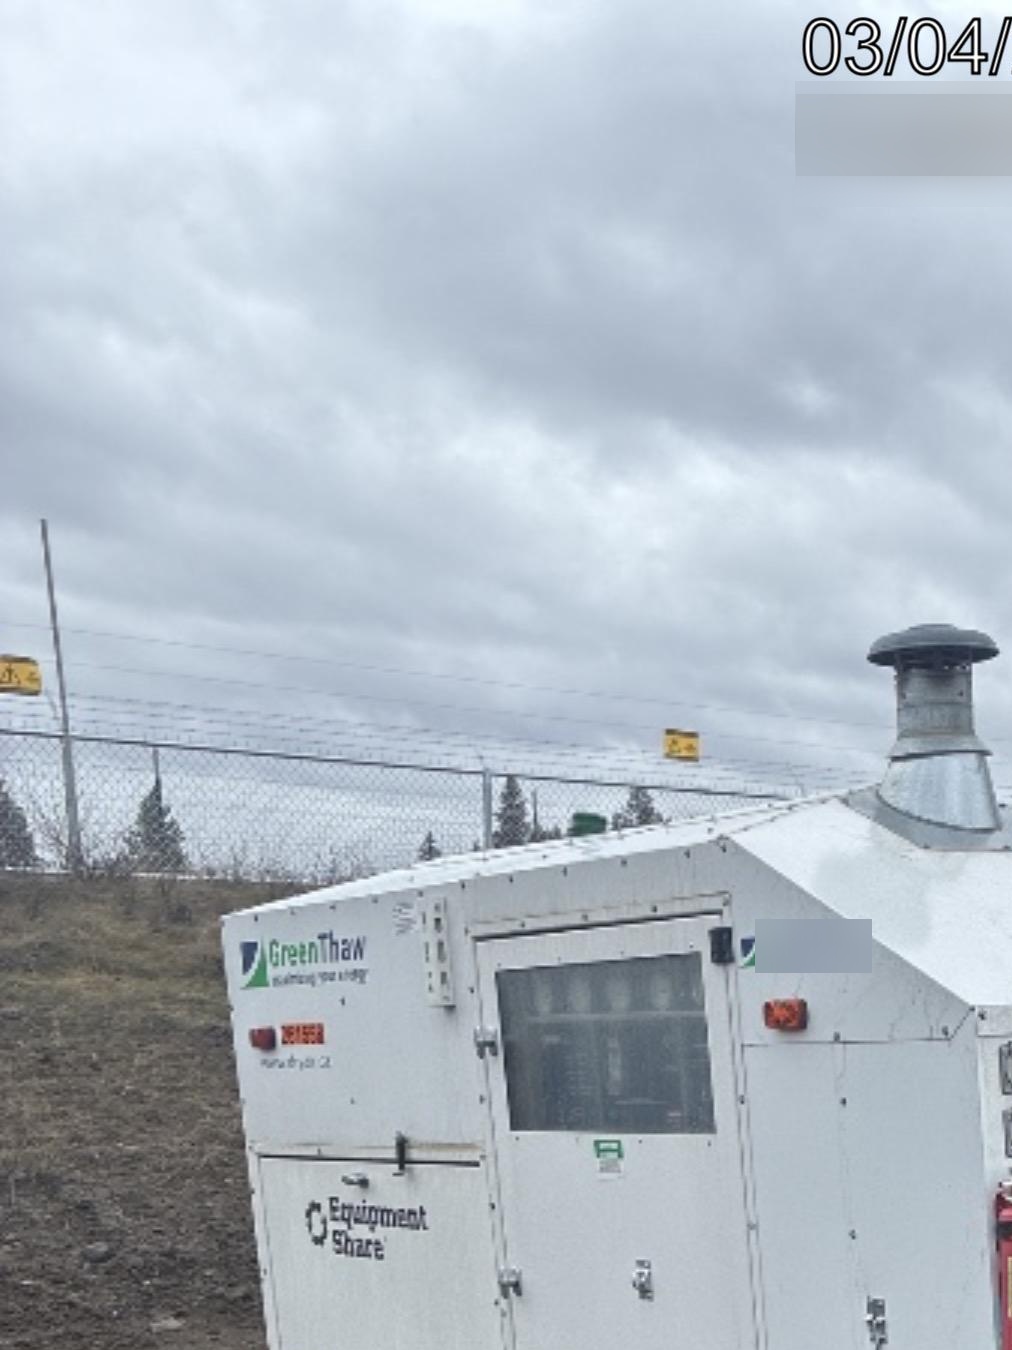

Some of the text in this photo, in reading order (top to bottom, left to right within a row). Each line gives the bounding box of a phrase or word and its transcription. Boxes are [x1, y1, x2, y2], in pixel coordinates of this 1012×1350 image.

[269, 930, 367, 967] GreenThaw
[328, 1196, 428, 1233] Equipment
[332, 1229, 385, 1260] Share
